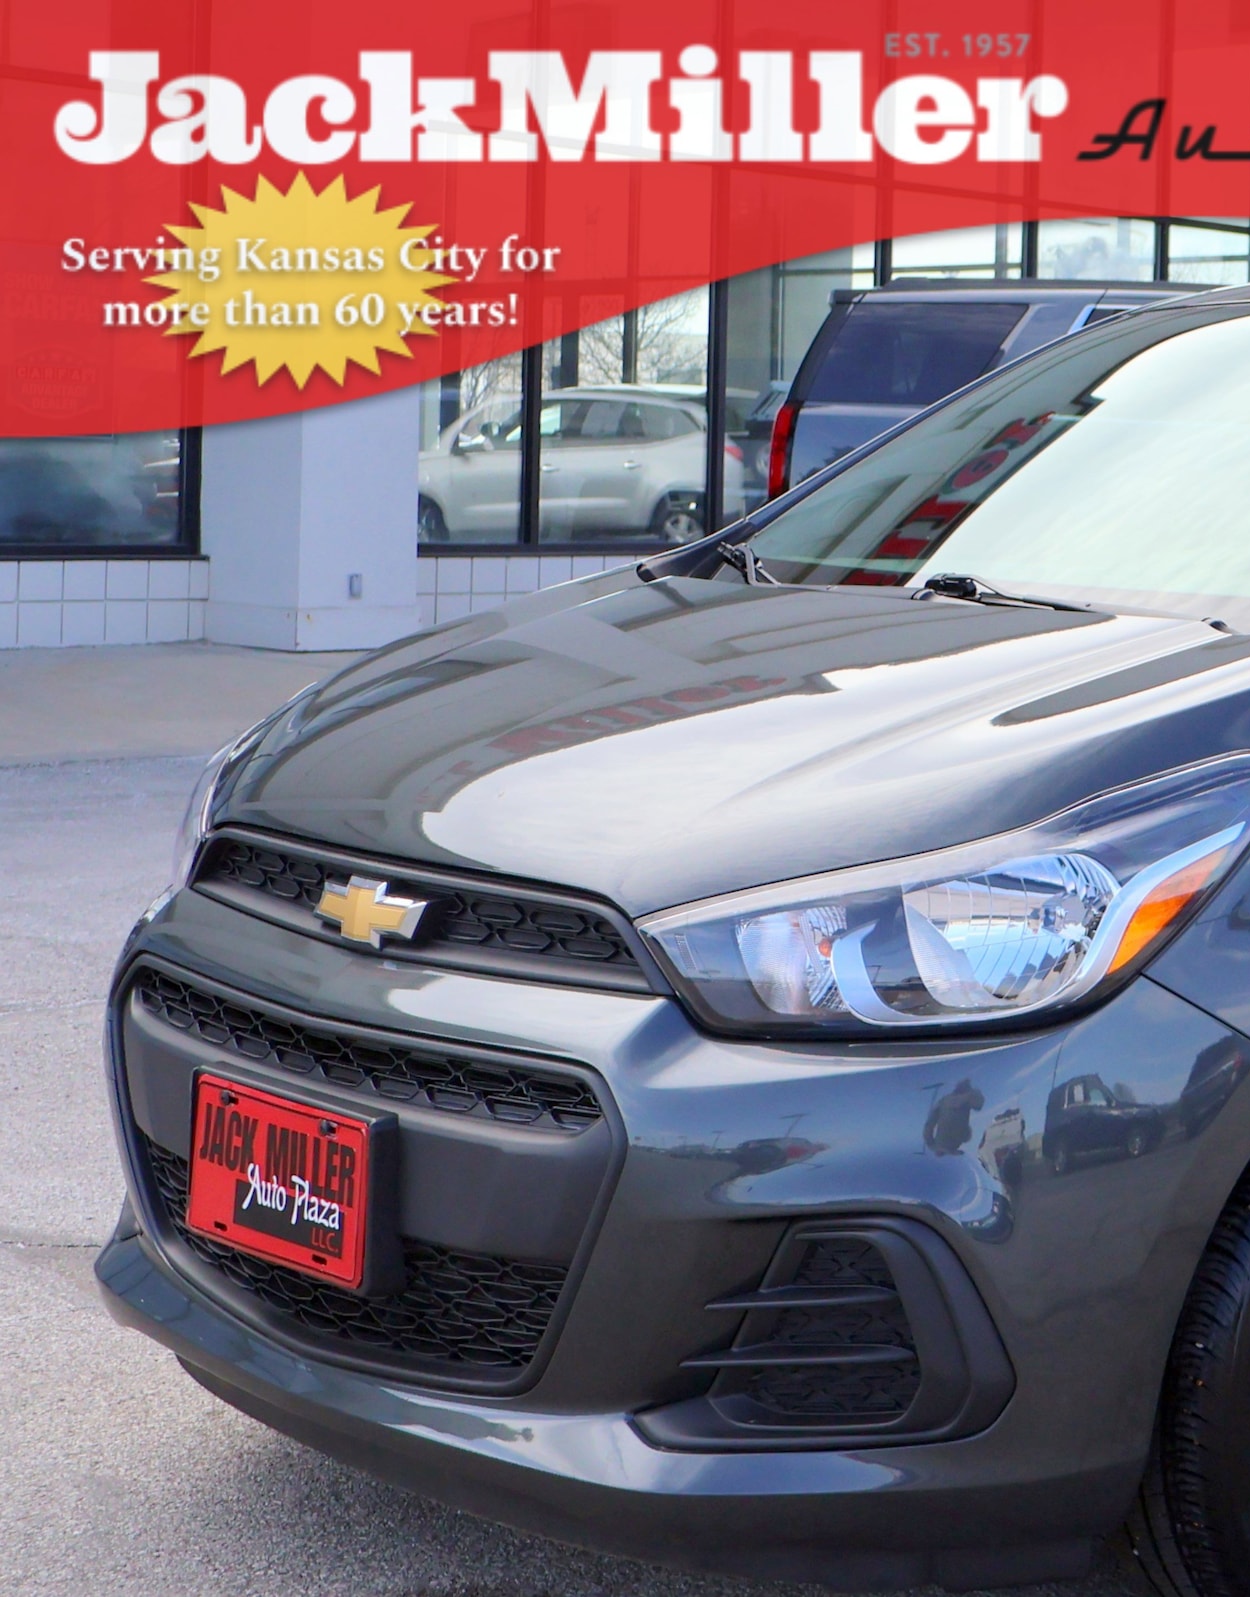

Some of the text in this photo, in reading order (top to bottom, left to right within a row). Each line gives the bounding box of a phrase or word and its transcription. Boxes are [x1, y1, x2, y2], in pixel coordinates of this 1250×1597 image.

[200, 1102, 357, 1209] JACK MILLER
[242, 1163, 340, 1230] Auto Plaza
